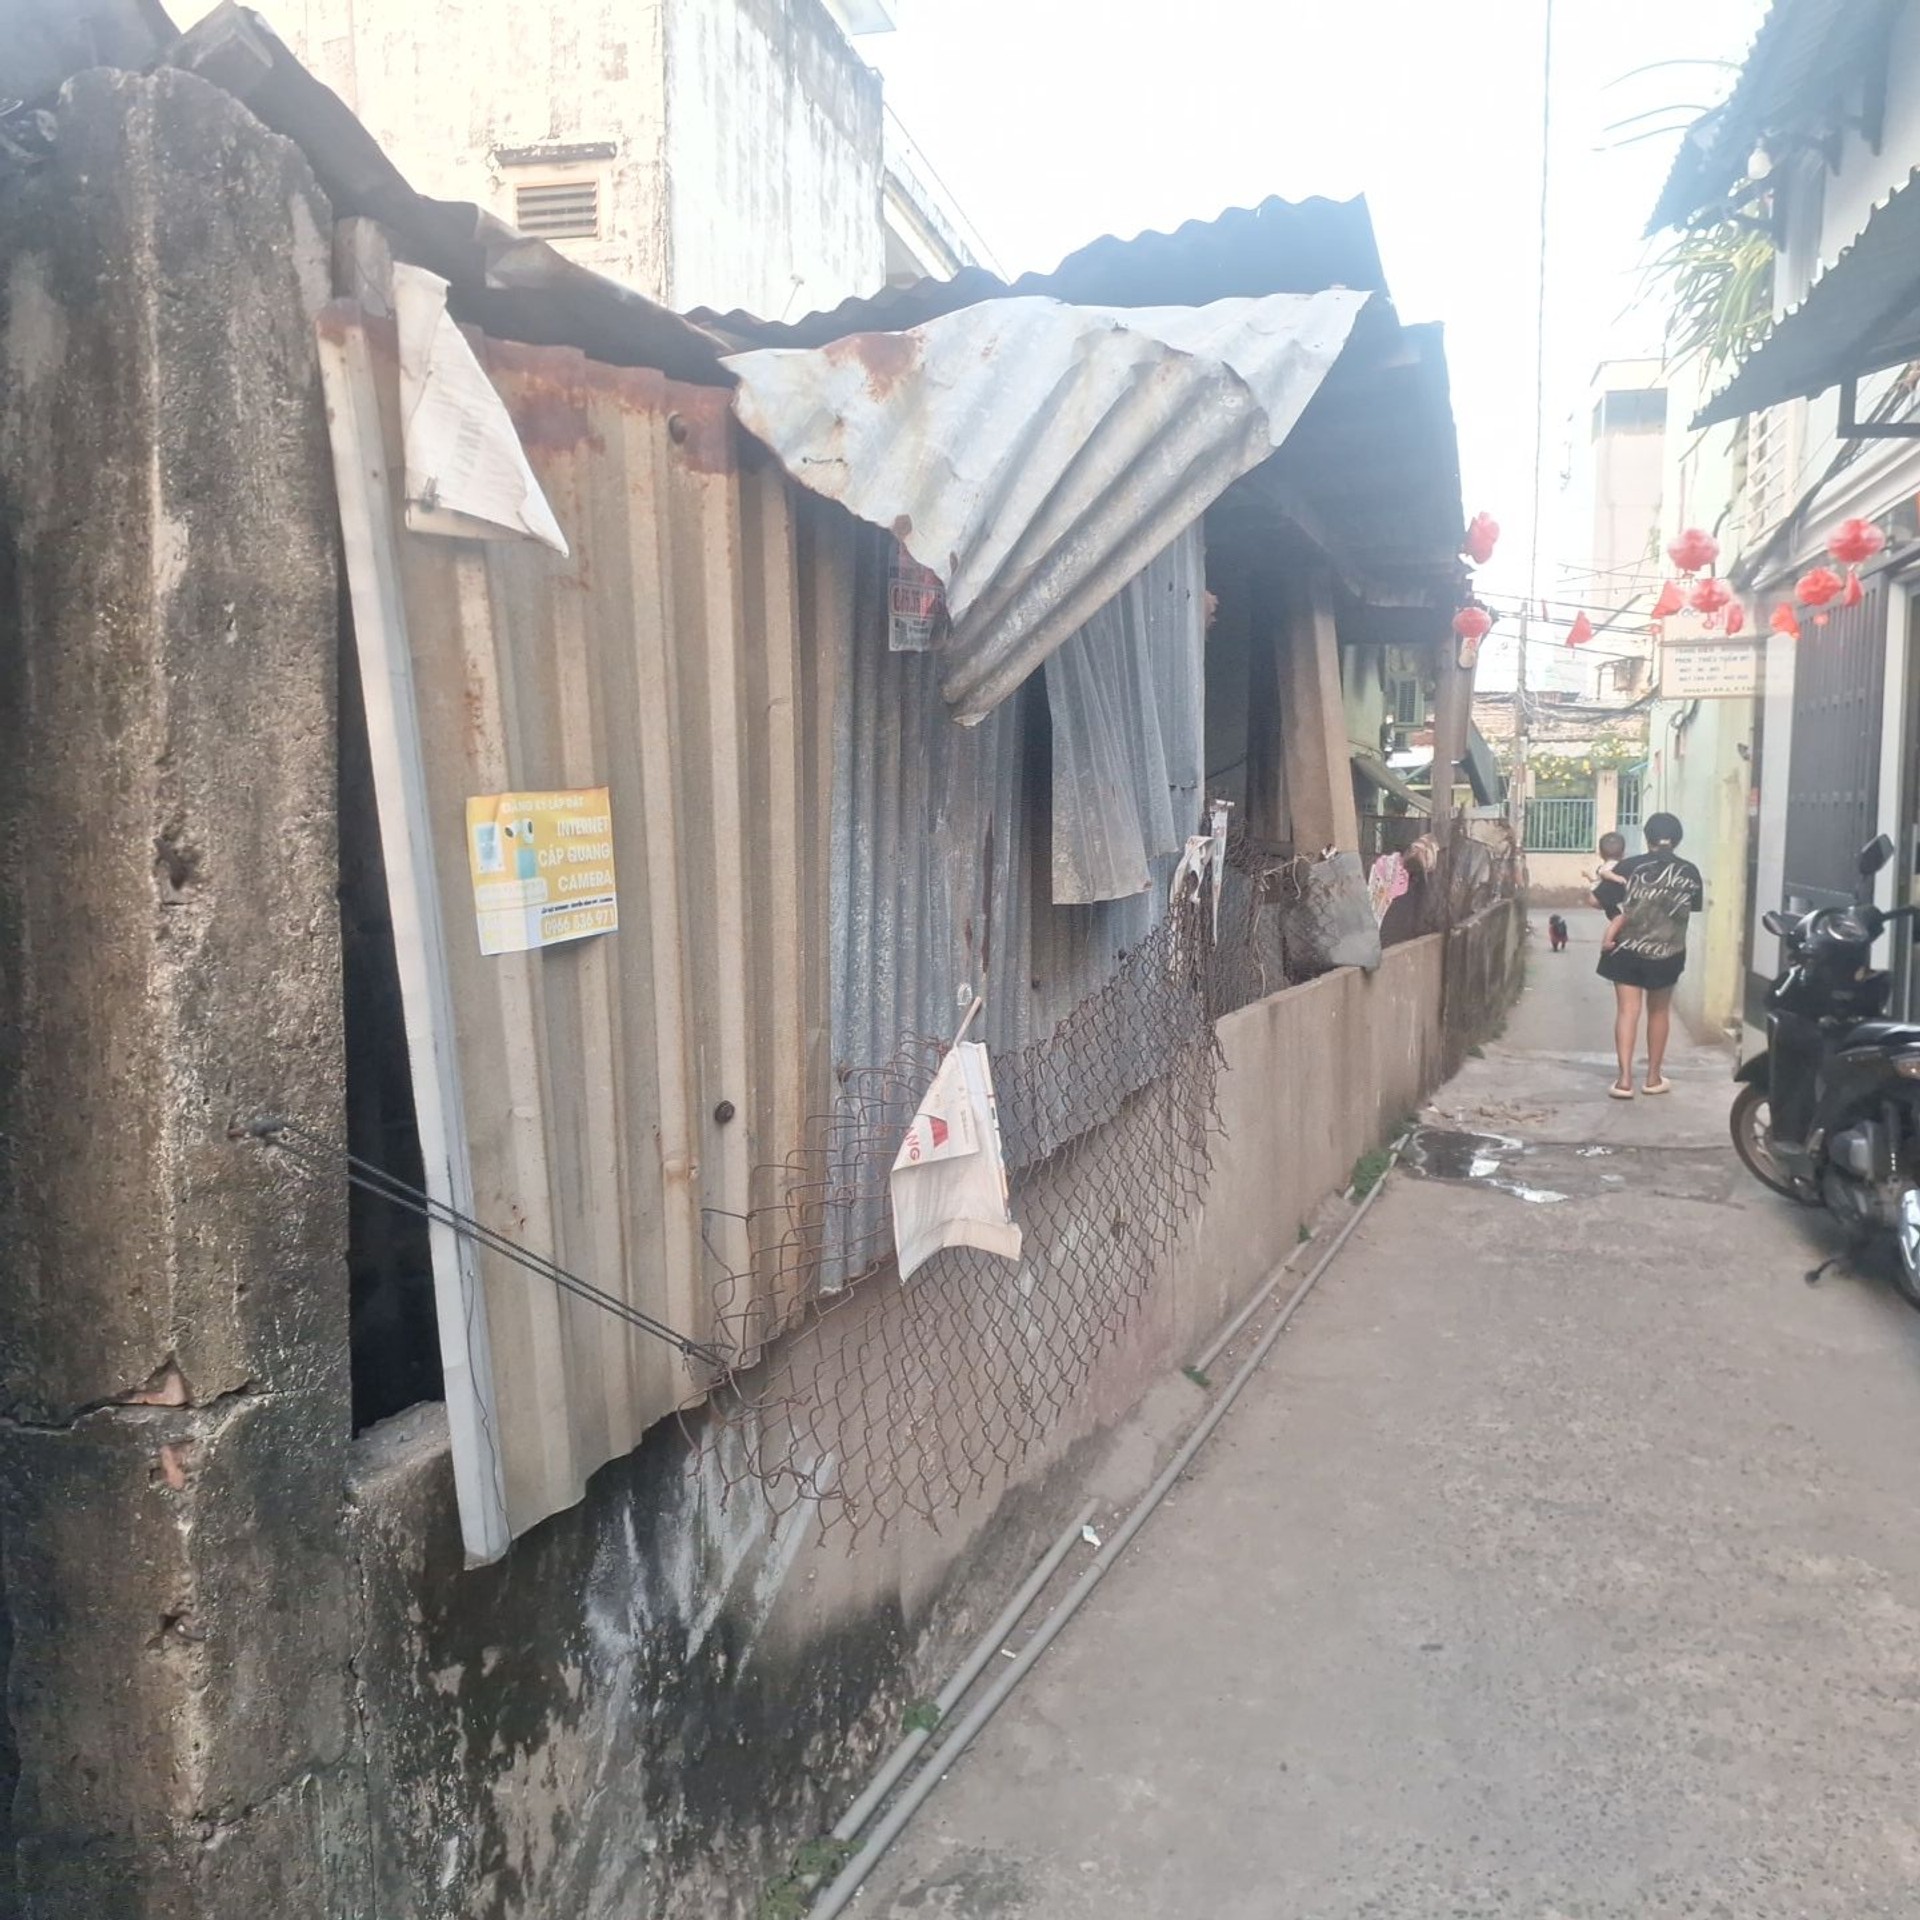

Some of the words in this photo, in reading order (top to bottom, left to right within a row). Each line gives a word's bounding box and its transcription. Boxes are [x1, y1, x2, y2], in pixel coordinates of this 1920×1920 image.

[557, 815, 609, 837] INTERNET
[538, 844, 565, 868] CÁP
[567, 842, 611, 863] QUANG
[558, 869, 615, 893] CAMERA
